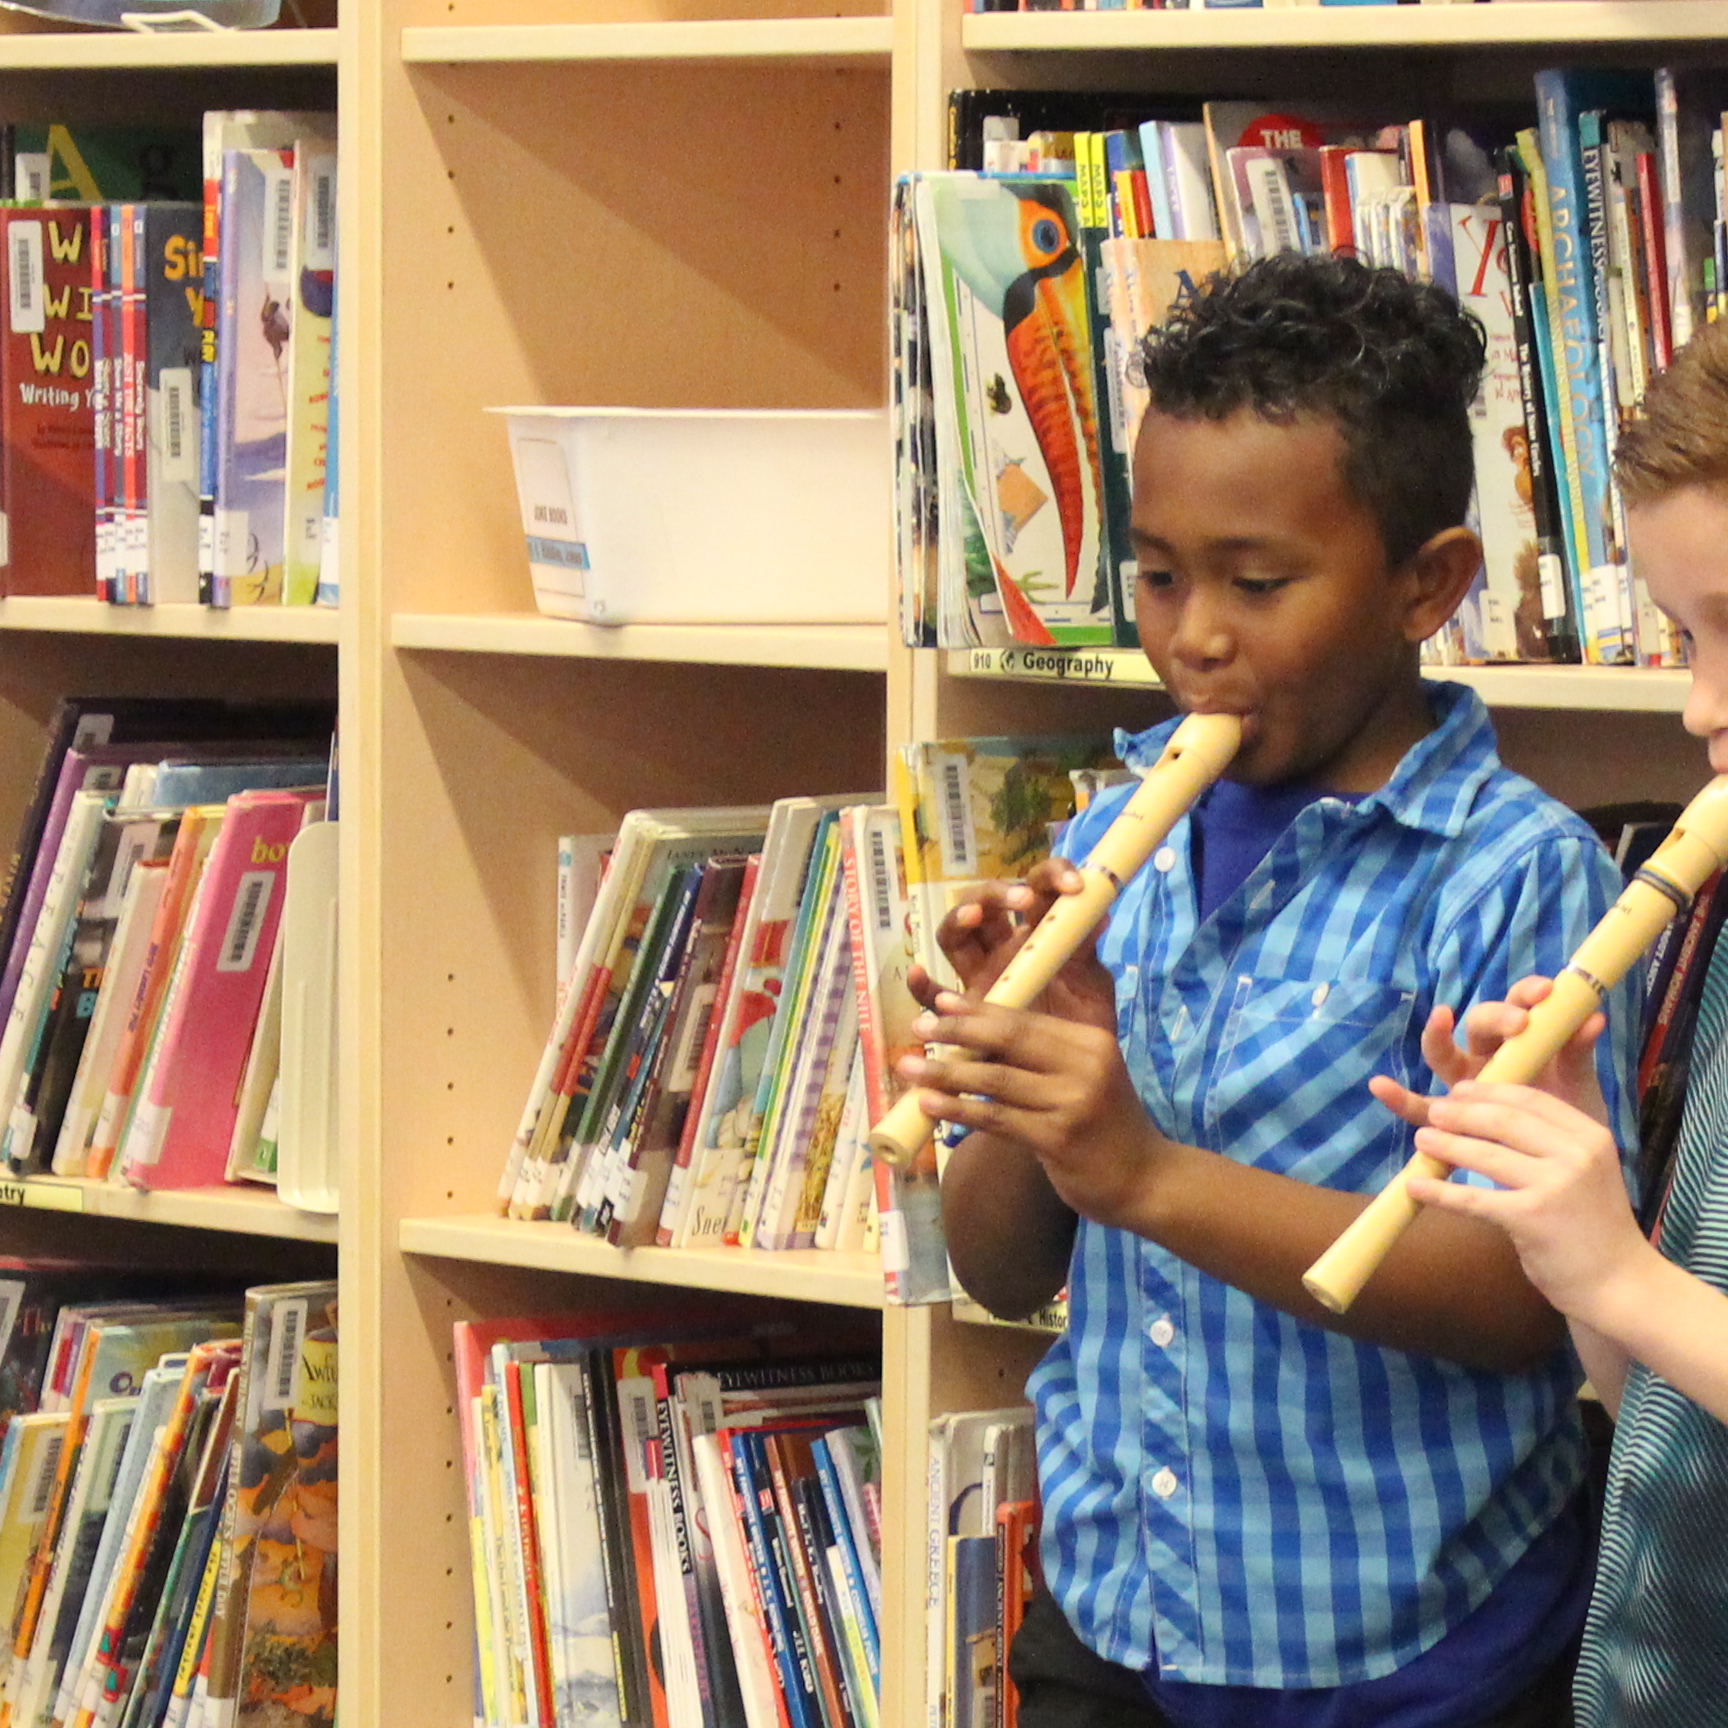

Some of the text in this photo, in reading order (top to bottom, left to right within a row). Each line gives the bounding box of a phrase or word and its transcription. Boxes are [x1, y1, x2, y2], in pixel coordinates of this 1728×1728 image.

[1261, 129, 1304, 149] THE
[1078, 164, 1089, 209] MAPS
[1093, 164, 1104, 209] MAPS
[1583, 149, 1608, 266] EYEWITNESS
[1547, 184, 1596, 479] ARCHAEOLOGY
[20, 383, 80, 412] Writing
[973, 651, 1114, 682] 910 Geography
[843, 849, 871, 1032] STORY THE NILE
[1038, 1308, 1068, 1329] Histor
[718, 1361, 874, 1390] EYEWITNESS BOOKS
[659, 1401, 692, 1575] EYEWITNESS BOOKS
[927, 1457, 943, 1608] ANCIENT GREECE
